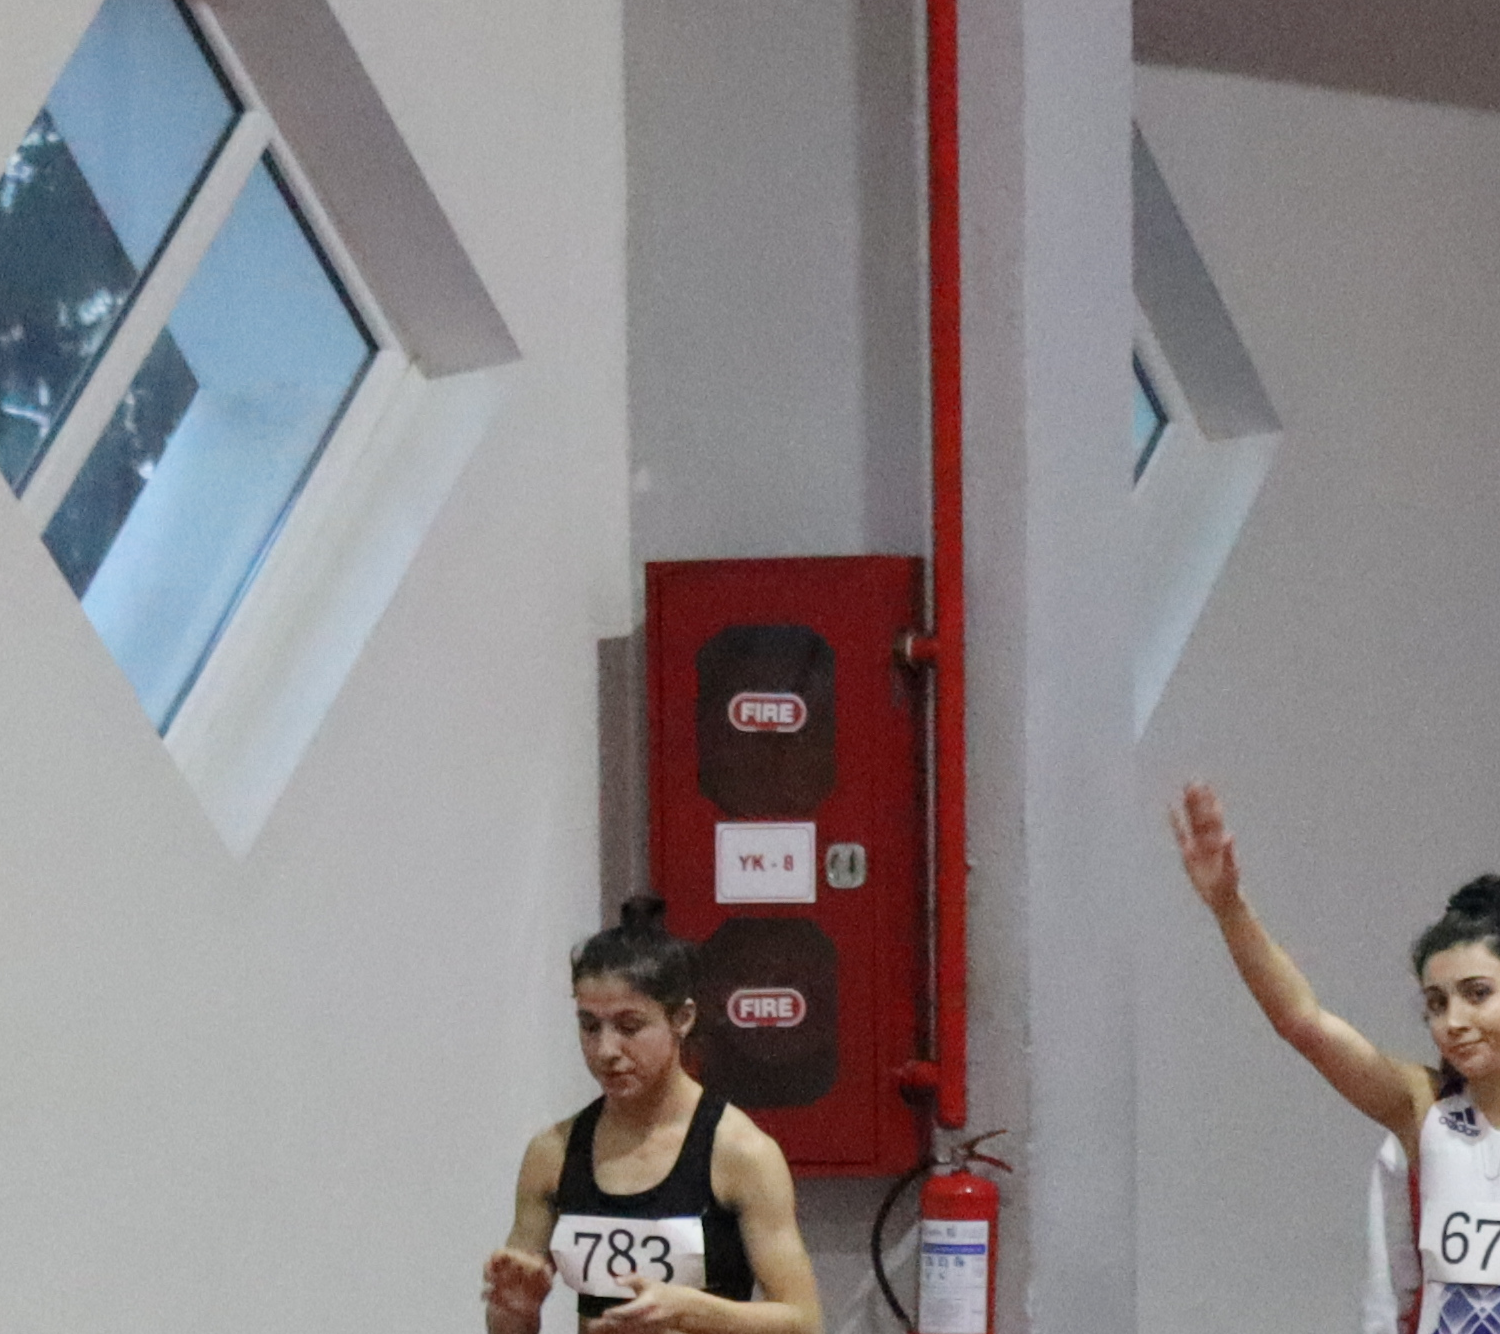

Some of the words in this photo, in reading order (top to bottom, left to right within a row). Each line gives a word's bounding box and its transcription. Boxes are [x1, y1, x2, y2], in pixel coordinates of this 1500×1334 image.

[740, 703, 795, 724] FIRE
[738, 853, 766, 872] YK
[740, 998, 794, 1019] FIRE
[573, 1230, 675, 1284] 783
